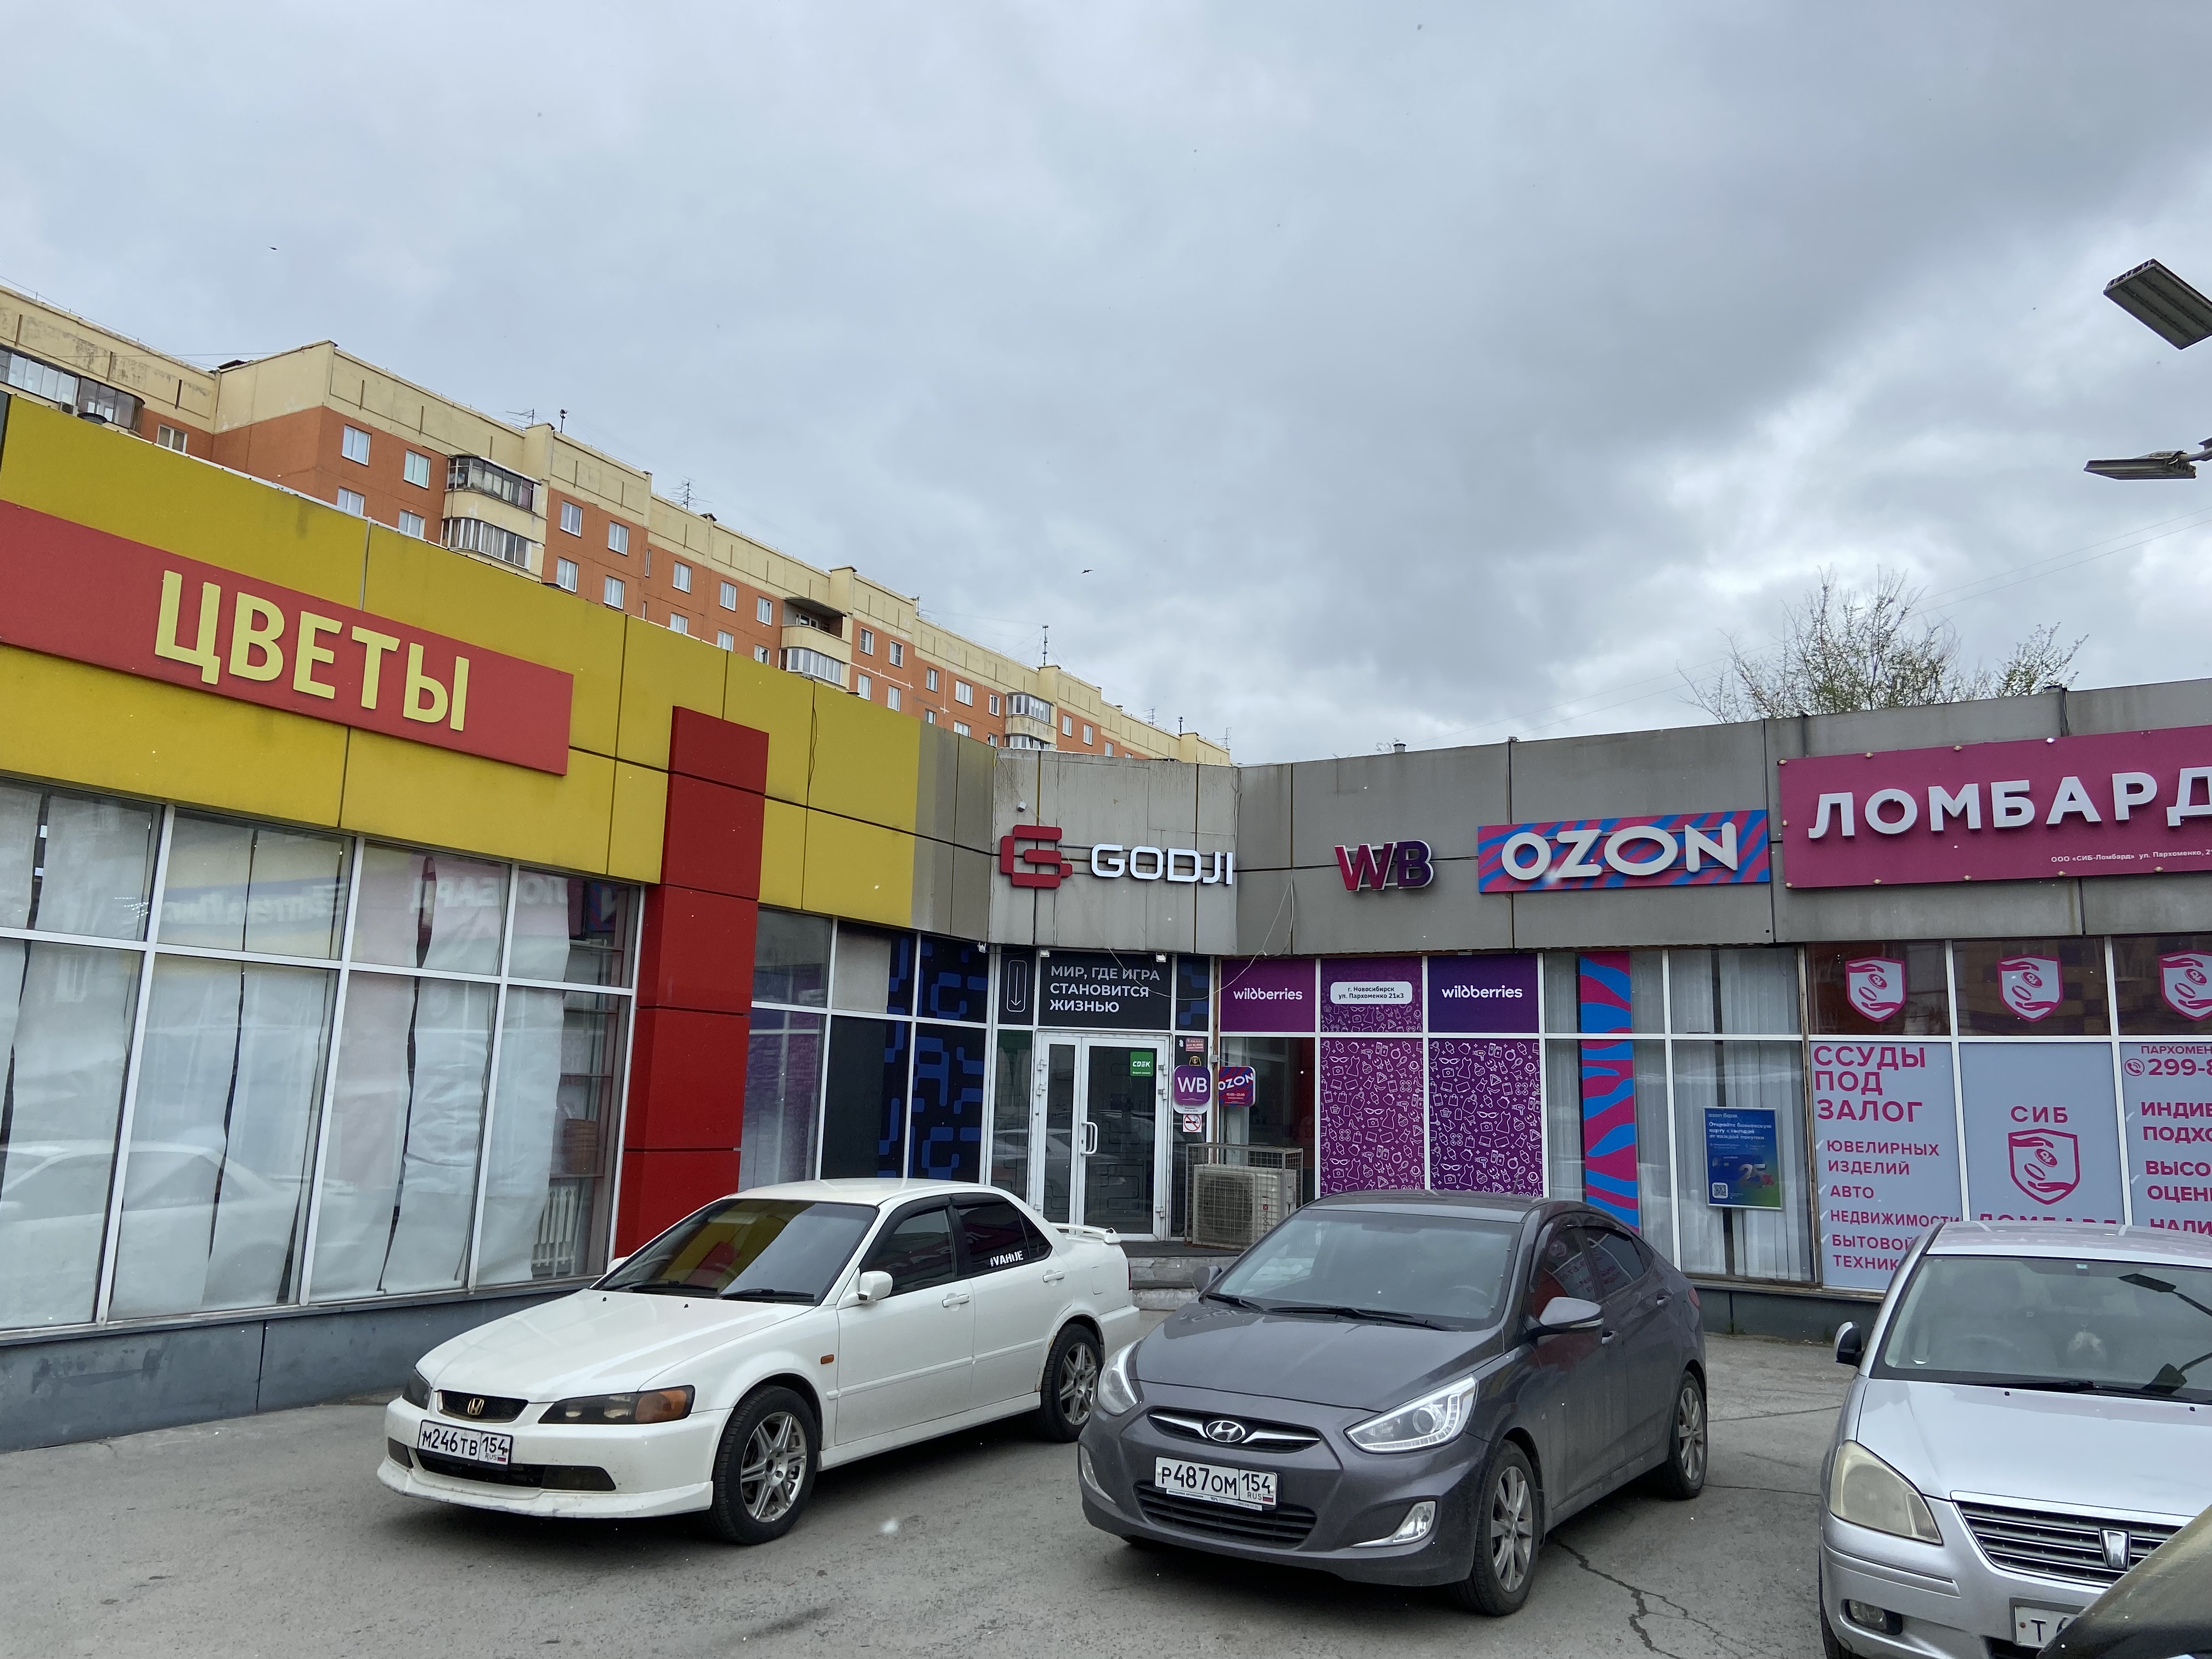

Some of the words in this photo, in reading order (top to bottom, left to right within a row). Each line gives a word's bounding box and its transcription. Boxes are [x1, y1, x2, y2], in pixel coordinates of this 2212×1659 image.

[154, 570, 469, 731] ЦВЕТЫ
[1808, 766, 2212, 839] ЛОМБАРД
[1501, 822, 1738, 881] OZON
[2153, 850, 2204, 859] Пархоменко,
[1091, 843, 1233, 885] GODJI
[1335, 840, 1434, 891] WB
[1051, 965, 1088, 980] МИР,
[1092, 966, 1120, 981] ГДЕ
[1124, 967, 1160, 981] ИГРА
[1050, 982, 1149, 998] СТАНОВИТСЯ
[1233, 987, 1302, 1001] wildberries
[1441, 985, 1523, 999] wildberries
[1049, 999, 1120, 1013] ЖИЗНЬЮ
[1814, 1046, 1926, 1070] ССУДЫ
[1177, 1077, 1207, 1093] WB
[1218, 1073, 1254, 1091] OZON
[1815, 1071, 1883, 1096] ПОД
[1818, 1099, 1922, 1122] ЗАЛОГ
[2011, 1106, 2068, 1124] СИБ
[1827, 1139, 1939, 1156] ЮВЕЛИРНЫХ
[1828, 1159, 1910, 1176] ИЗДЕЛИЙ
[1830, 1185, 1874, 1199] АВТО
[2147, 1185, 2212, 1203] ОЦЕН
[422, 1428, 477, 1456] М246ТВ
[482, 1436, 506, 1455] 154
[485, 1453, 497, 1461] RUS
[1161, 1464, 1237, 1496] Р487ОМ
[1242, 1473, 1271, 1494] 154
[1247, 1492, 1262, 1500] RUS
